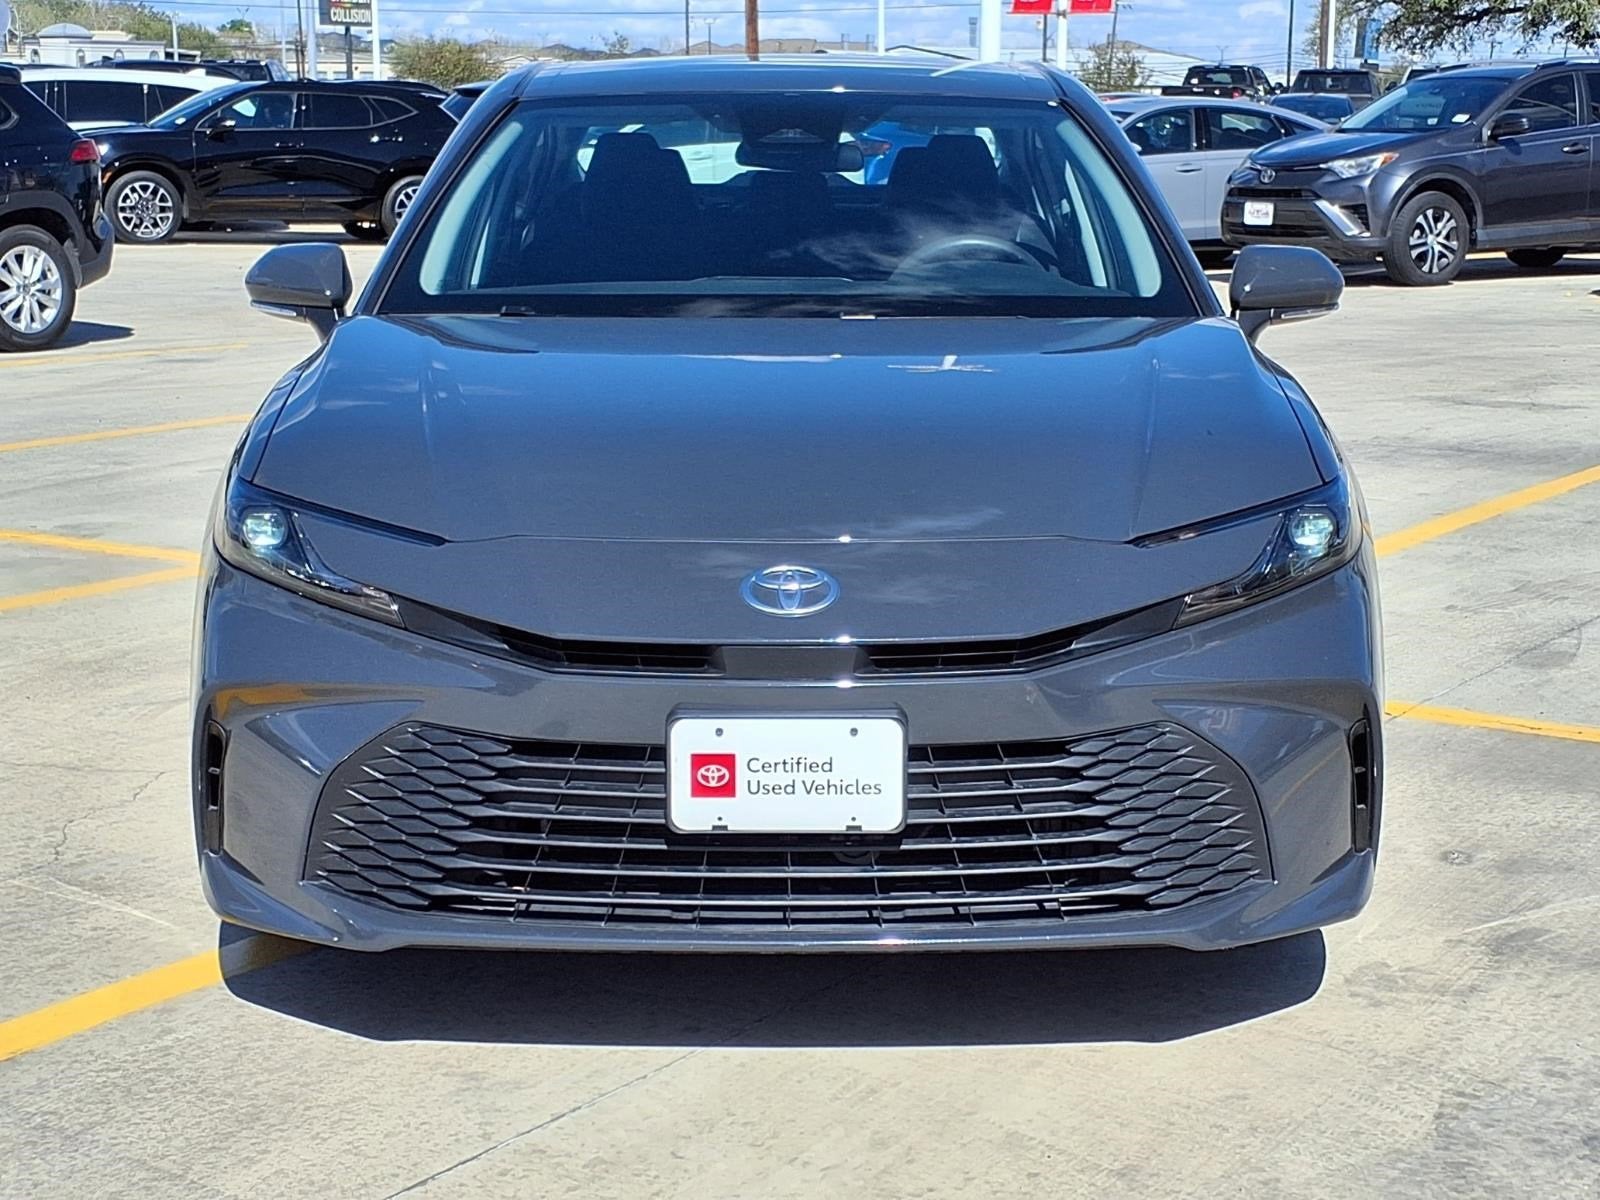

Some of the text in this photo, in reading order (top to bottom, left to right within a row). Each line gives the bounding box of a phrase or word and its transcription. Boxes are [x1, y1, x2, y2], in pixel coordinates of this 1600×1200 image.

[330, 7, 371, 24] COLLISION
[746, 757, 833, 773] Certified
[746, 779, 882, 795] Used Vehicles
